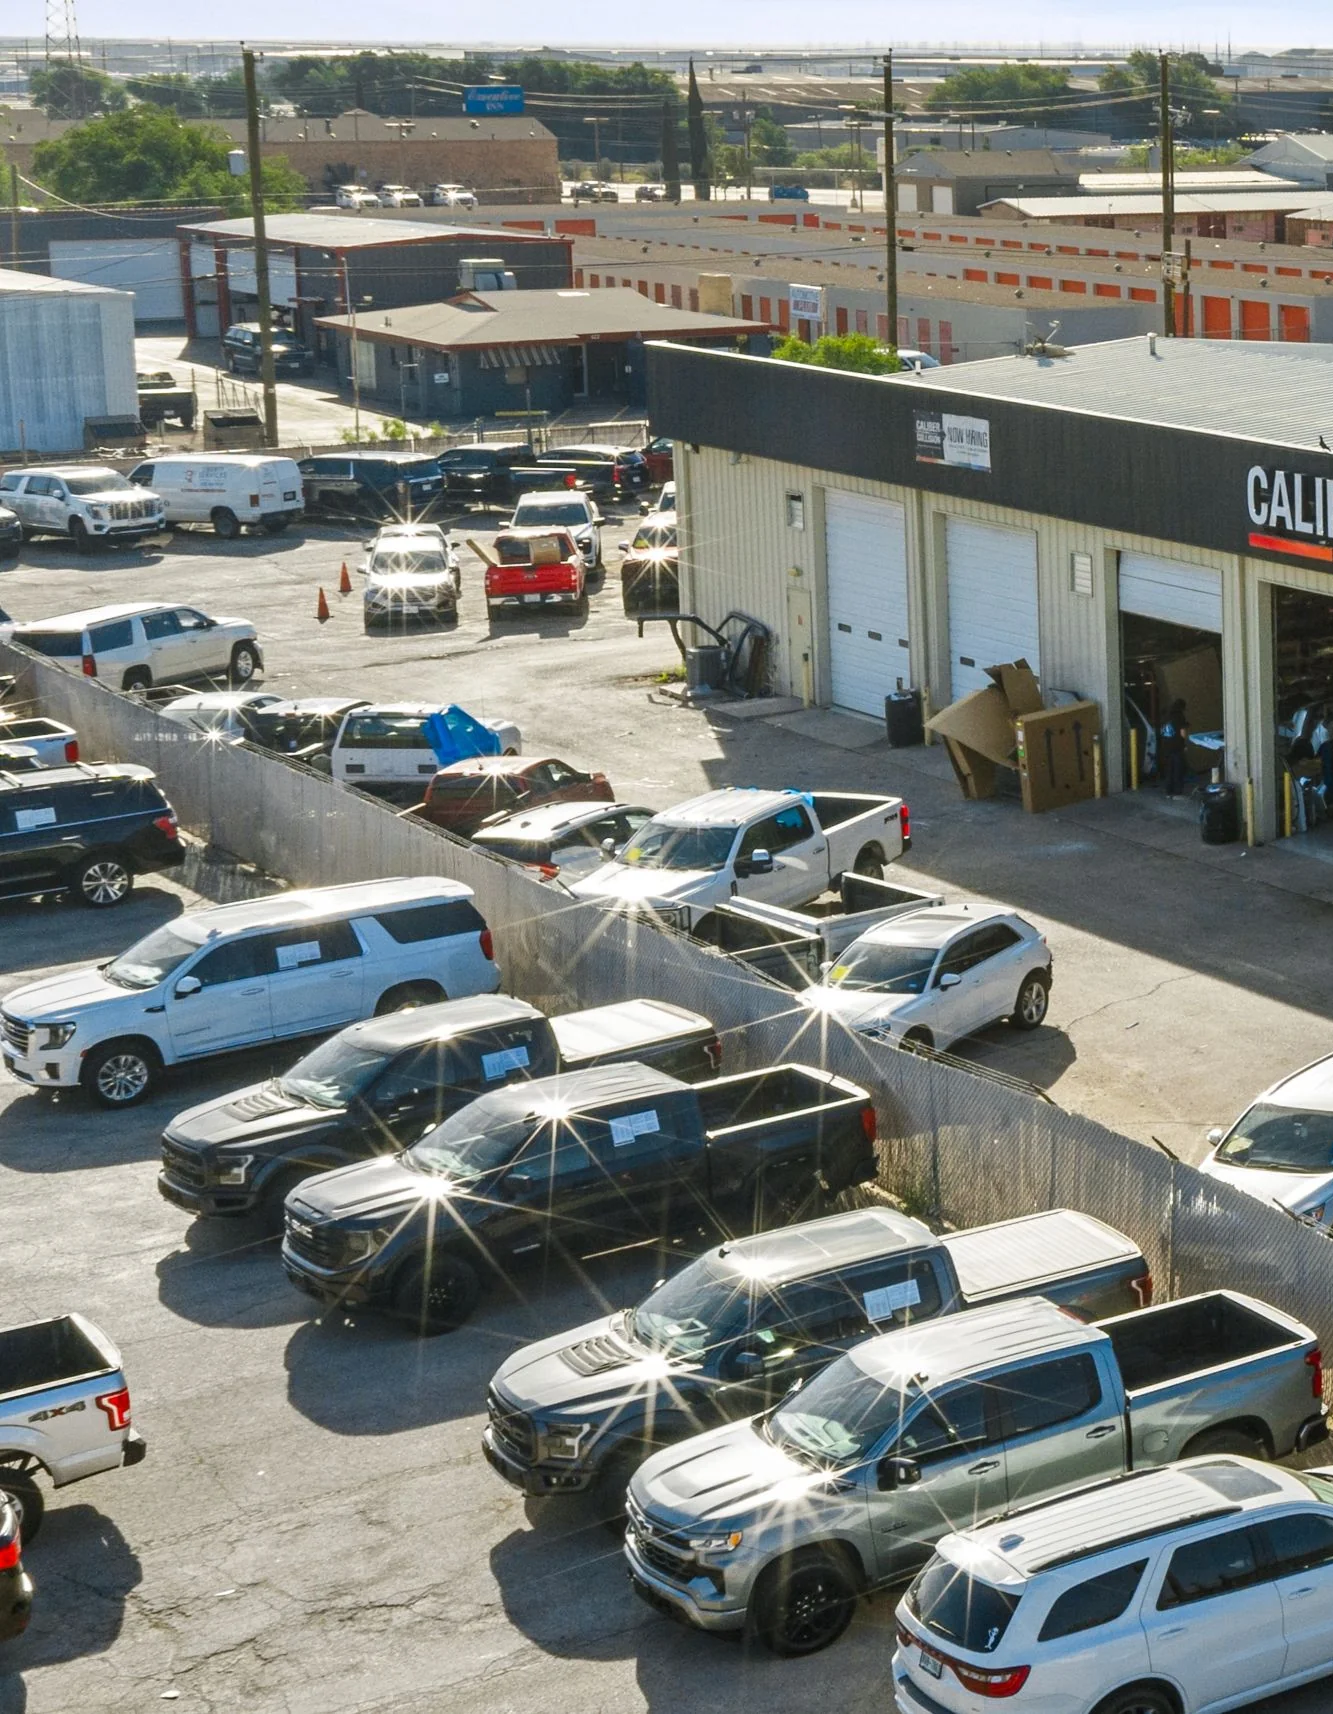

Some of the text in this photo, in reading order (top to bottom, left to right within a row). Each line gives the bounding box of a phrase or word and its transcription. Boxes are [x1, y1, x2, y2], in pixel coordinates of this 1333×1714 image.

[916, 420, 940, 432] CALIBER
[947, 426, 988, 448] NOW HIRING
